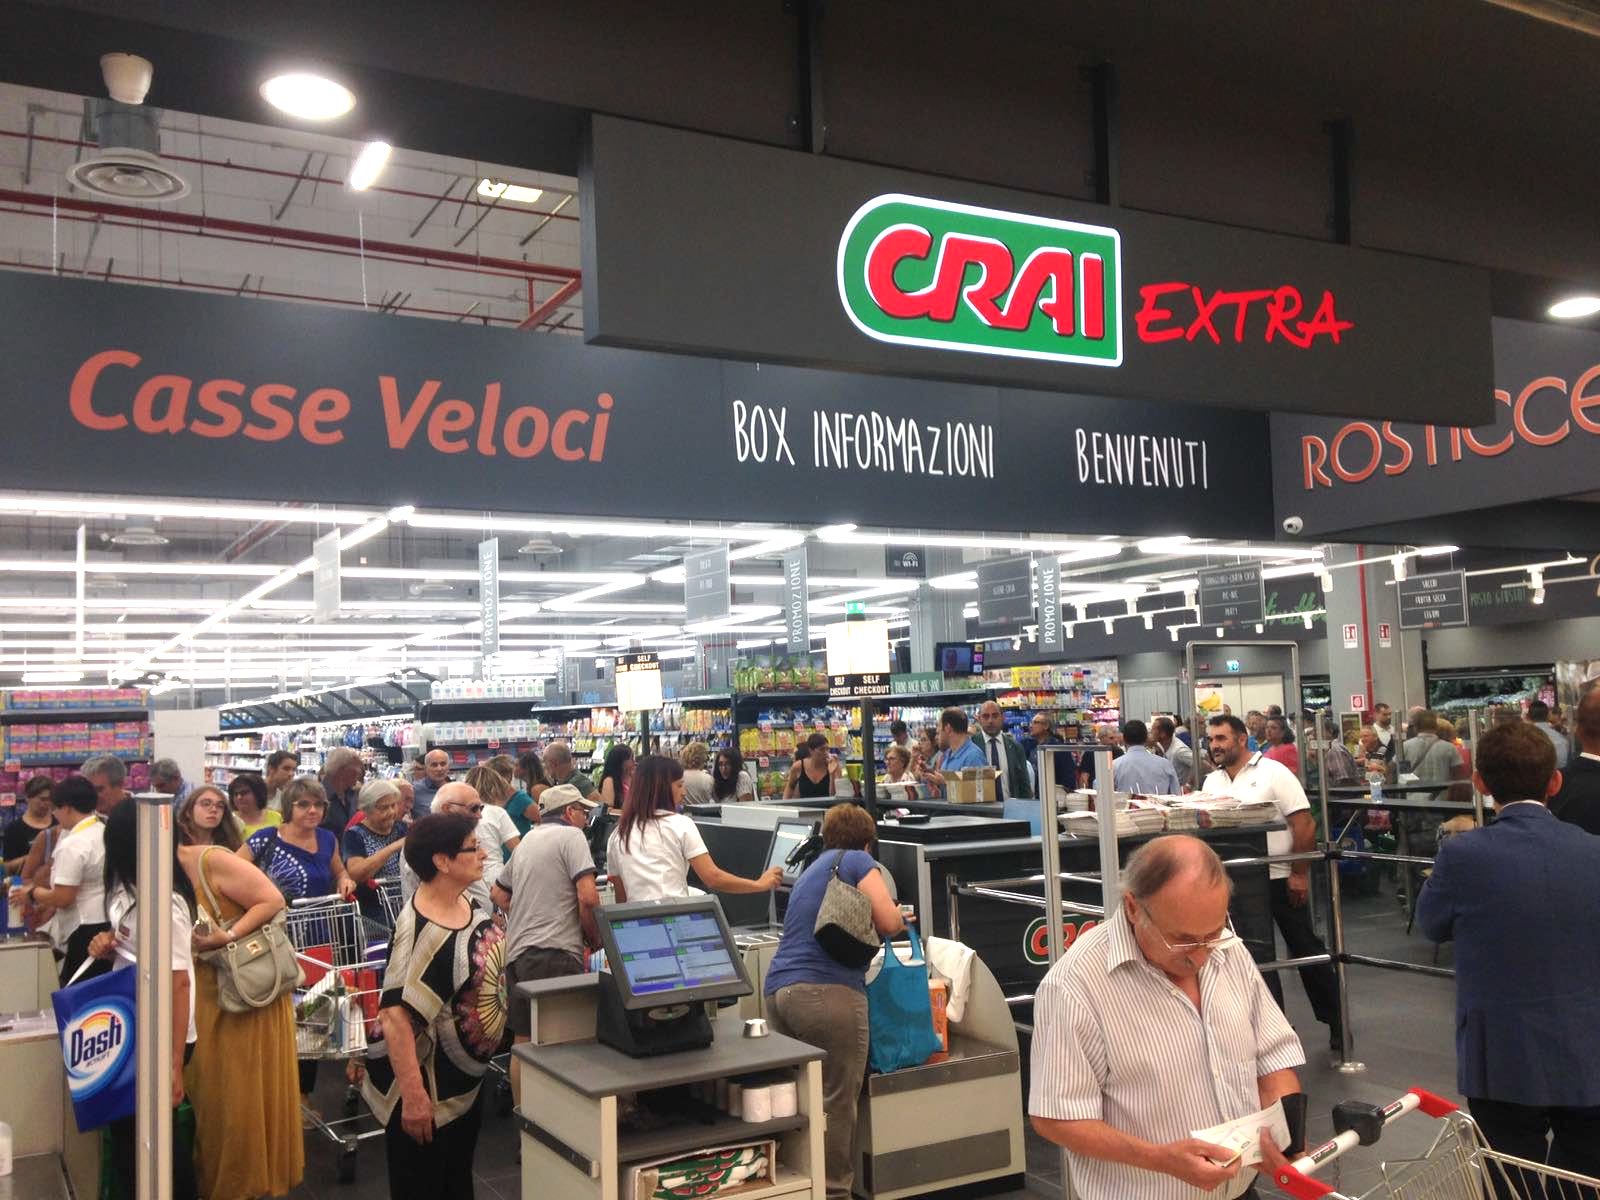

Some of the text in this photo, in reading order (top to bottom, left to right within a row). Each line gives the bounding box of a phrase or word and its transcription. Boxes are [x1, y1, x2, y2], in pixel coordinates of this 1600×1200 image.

[866, 225, 1354, 349] CRAI EXTRA
[69, 350, 613, 463] Casse Veloci
[733, 399, 994, 479] BOX INFORMAZIONI
[1075, 428, 1208, 489] BENVENUTI
[483, 551, 494, 646] PROMOZIONE
[791, 558, 802, 644] PROMOZIONE
[1043, 567, 1056, 644] PROMOZIONE
[637, 654, 651, 663] SELF
[834, 676, 845, 686] SELF
[862, 675, 880, 684] SELF
[830, 687, 851, 696] CHECKOUT
[854, 685, 889, 695] CHECKOUT
[71, 1014, 122, 1068] Dash
